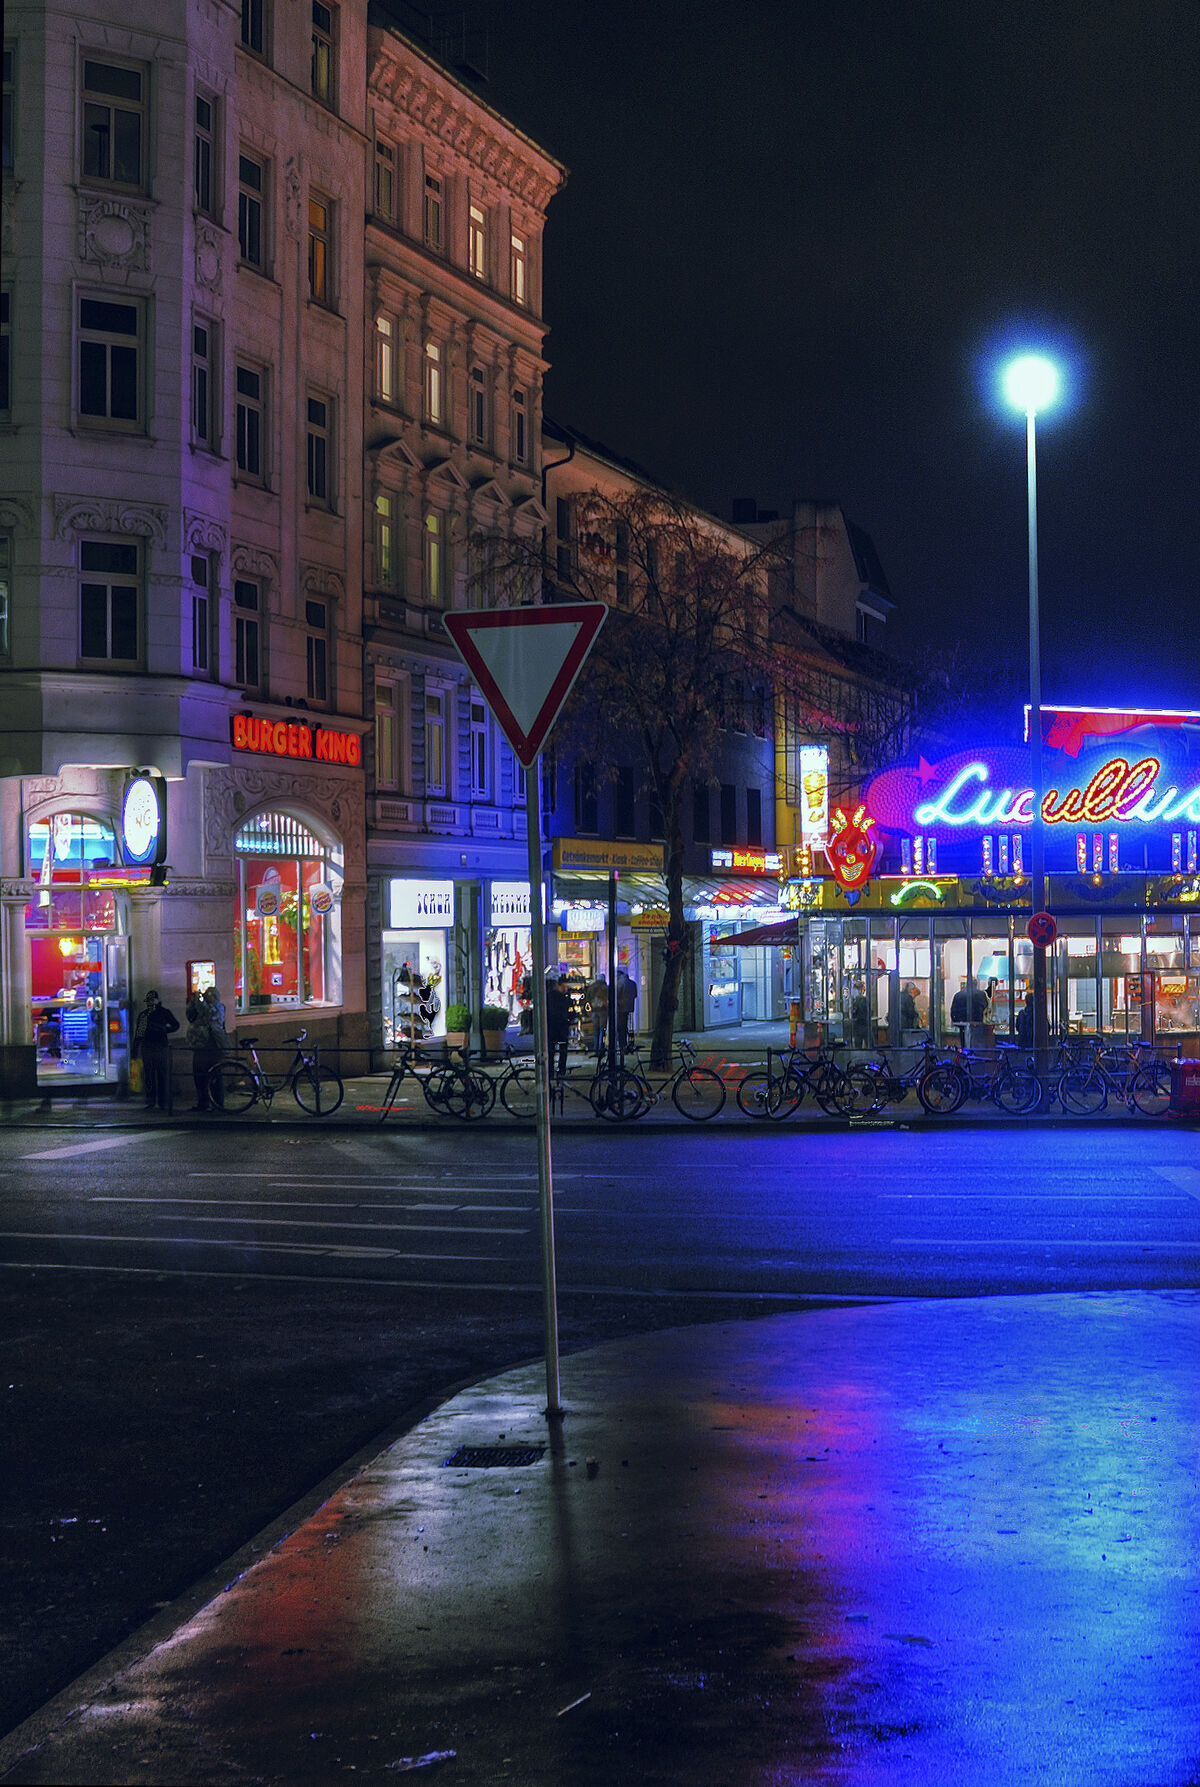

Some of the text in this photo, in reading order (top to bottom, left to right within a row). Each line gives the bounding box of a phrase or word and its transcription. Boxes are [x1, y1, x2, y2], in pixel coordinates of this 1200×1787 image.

[233, 714, 360, 766] BURGER KING
[491, 893, 531, 914] MESSME
